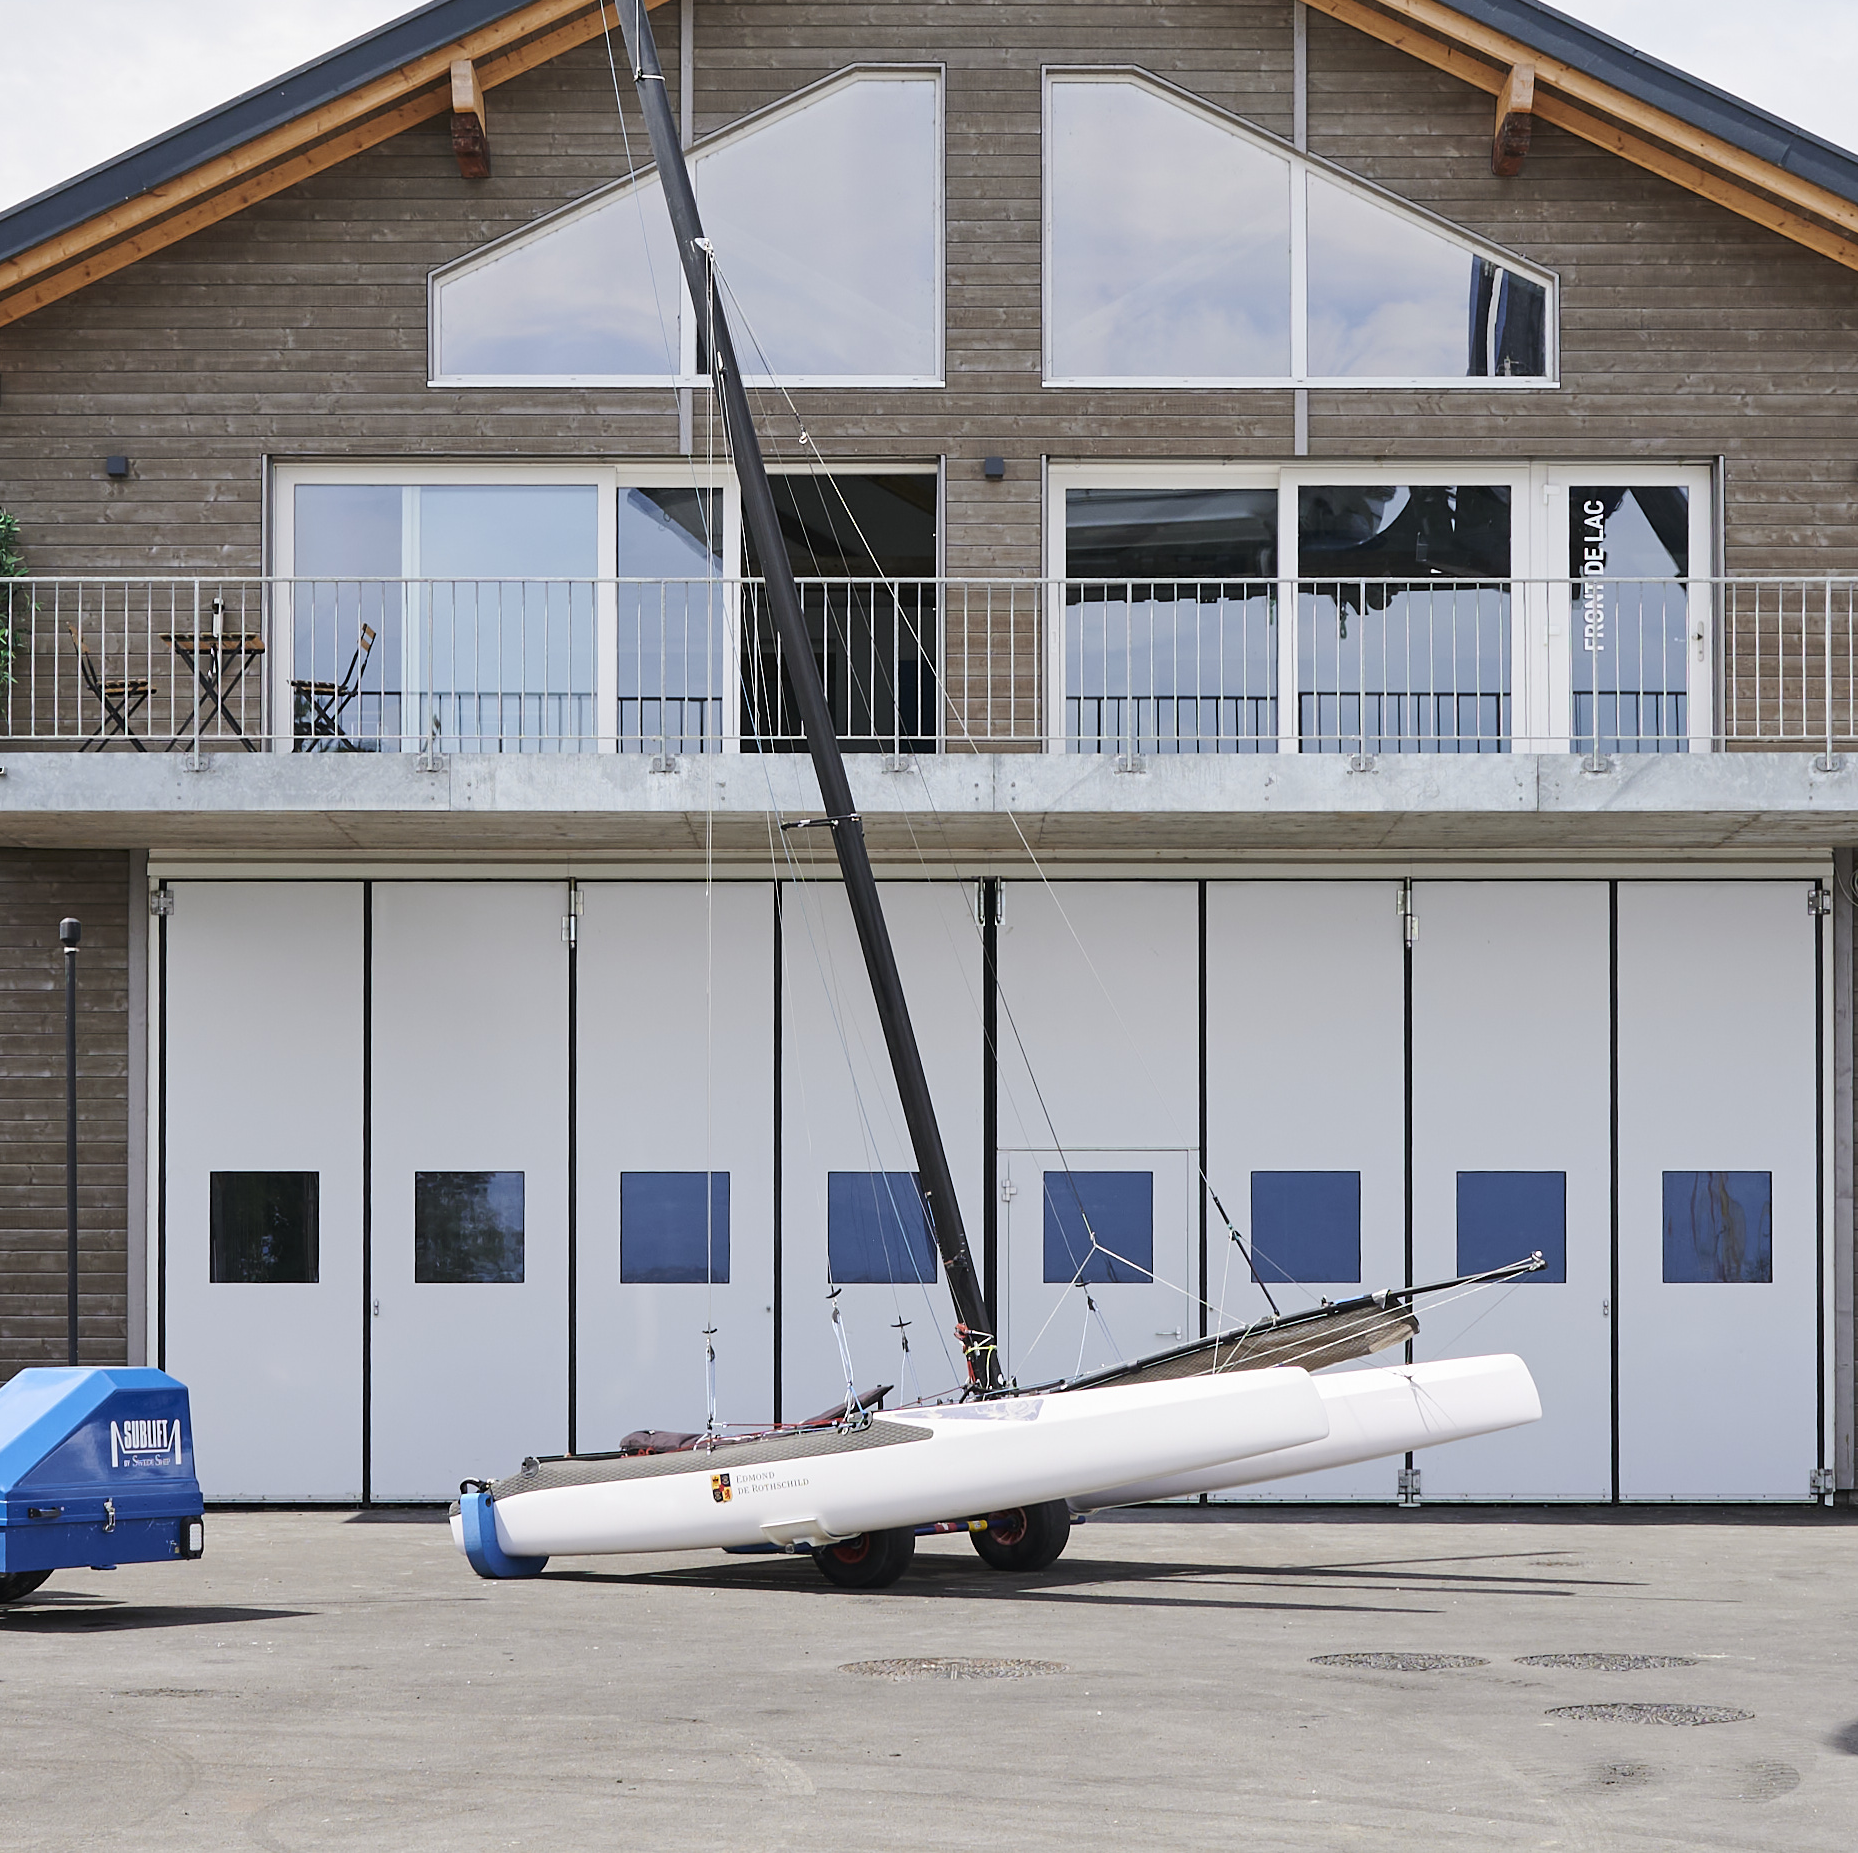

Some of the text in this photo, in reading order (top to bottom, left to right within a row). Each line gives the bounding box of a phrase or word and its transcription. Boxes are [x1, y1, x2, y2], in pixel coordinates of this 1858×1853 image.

[1583, 500, 1605, 651] FRONT DE LAC
[123, 1419, 168, 1449] SUBLIFT
[736, 1471, 775, 1483] EDMOND
[752, 1478, 809, 1493] ROTHSCHILD
